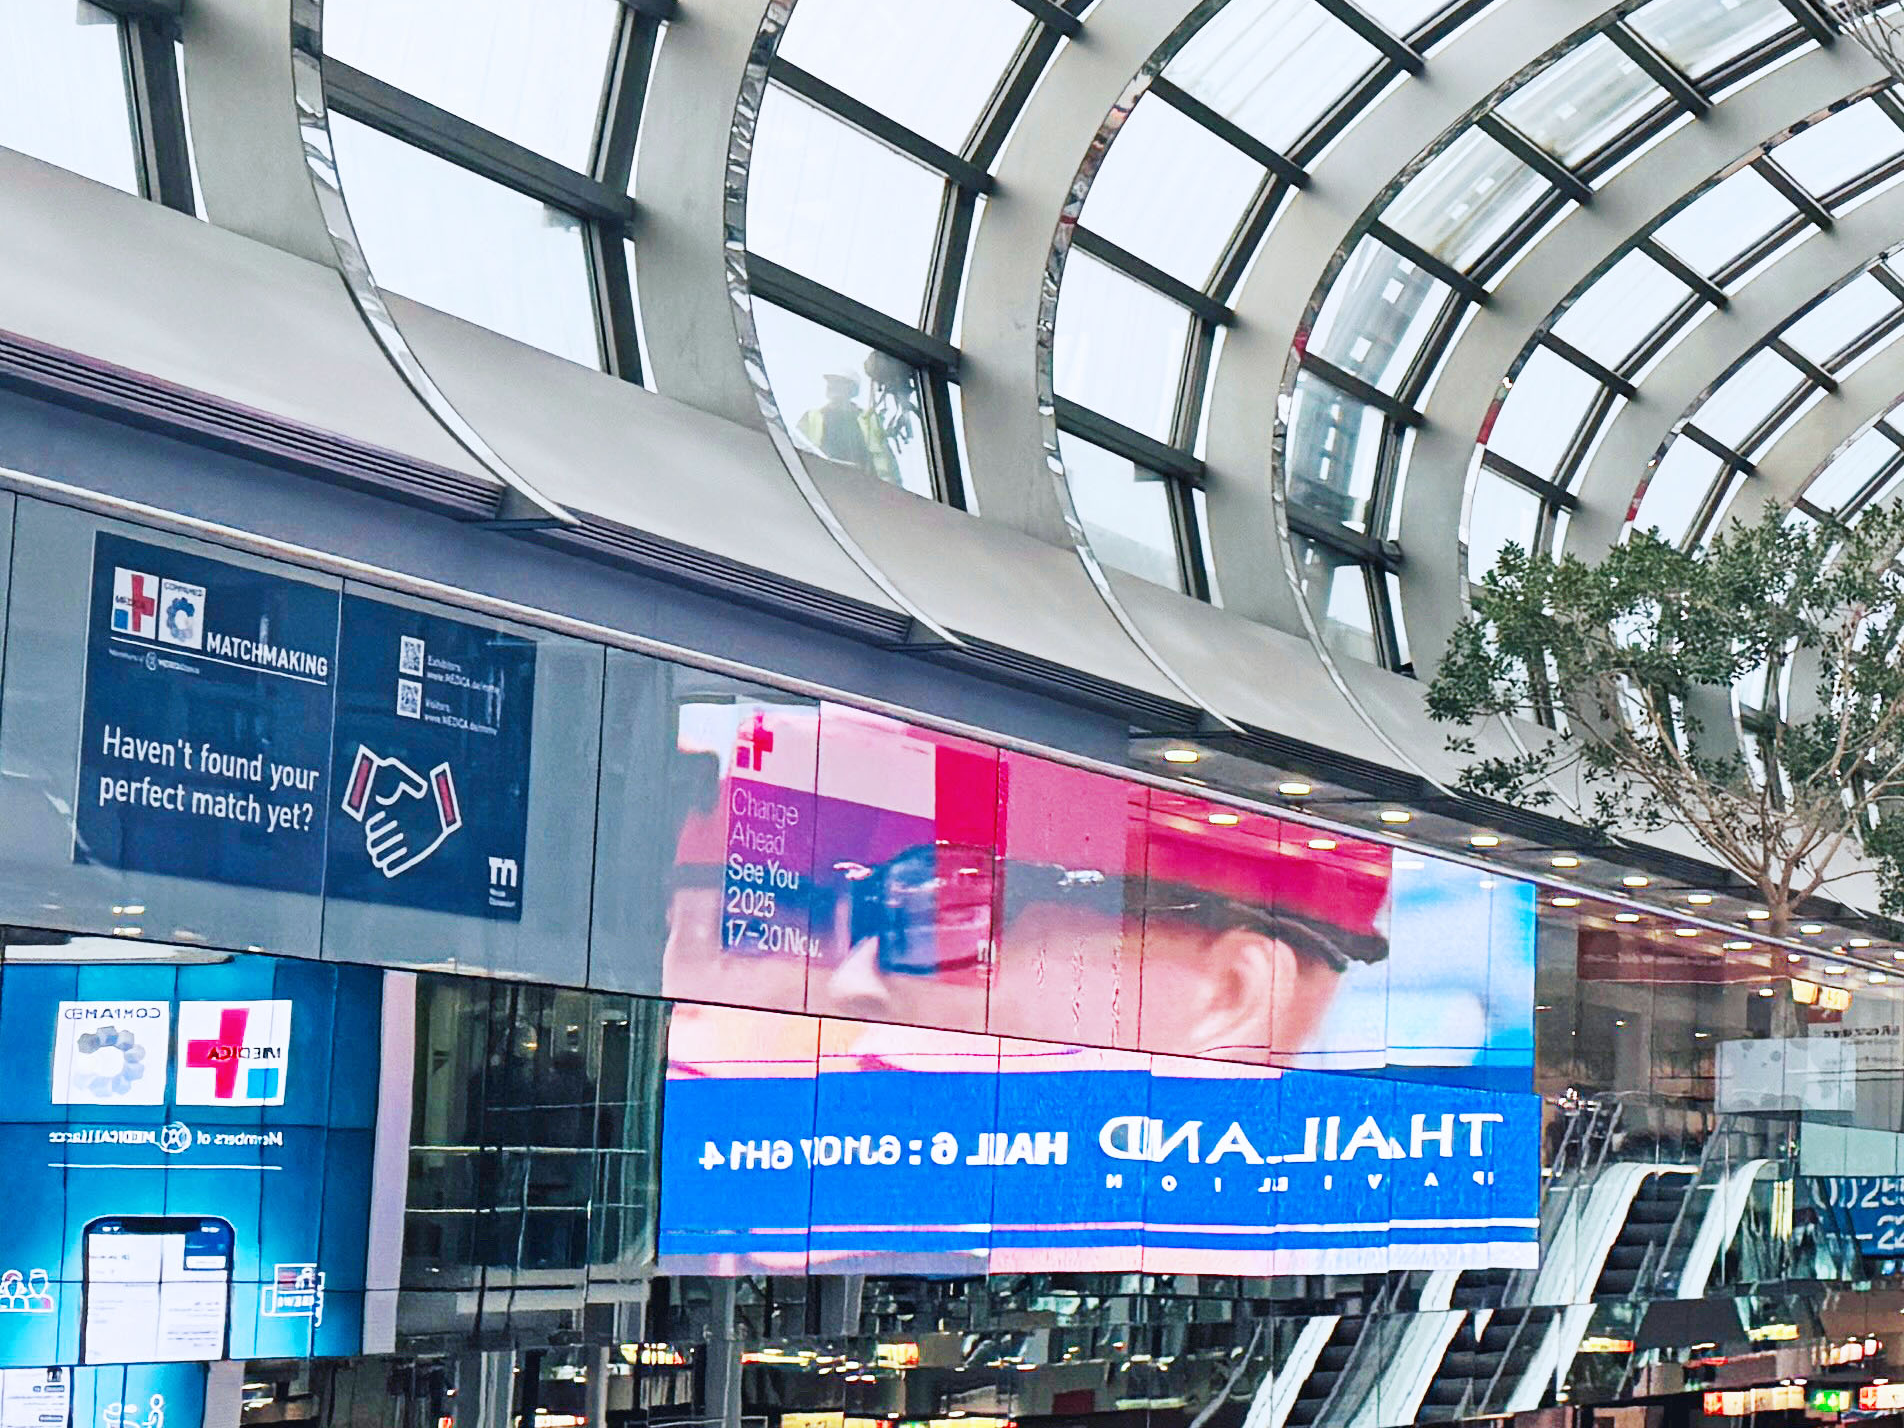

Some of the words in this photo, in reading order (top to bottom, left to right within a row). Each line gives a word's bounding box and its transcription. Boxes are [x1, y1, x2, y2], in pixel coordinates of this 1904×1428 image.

[207, 632, 328, 677] MATCHMAKING
[103, 724, 192, 770] Haven't
[200, 743, 262, 782] found
[270, 763, 320, 792] your
[99, 776, 185, 812] perfect
[192, 793, 260, 823] match
[267, 802, 313, 833] yet?
[732, 788, 799, 829] Change
[730, 822, 786, 855] Ahead
[728, 853, 765, 885] See
[767, 859, 800, 890] You
[727, 886, 775, 918] 2025
